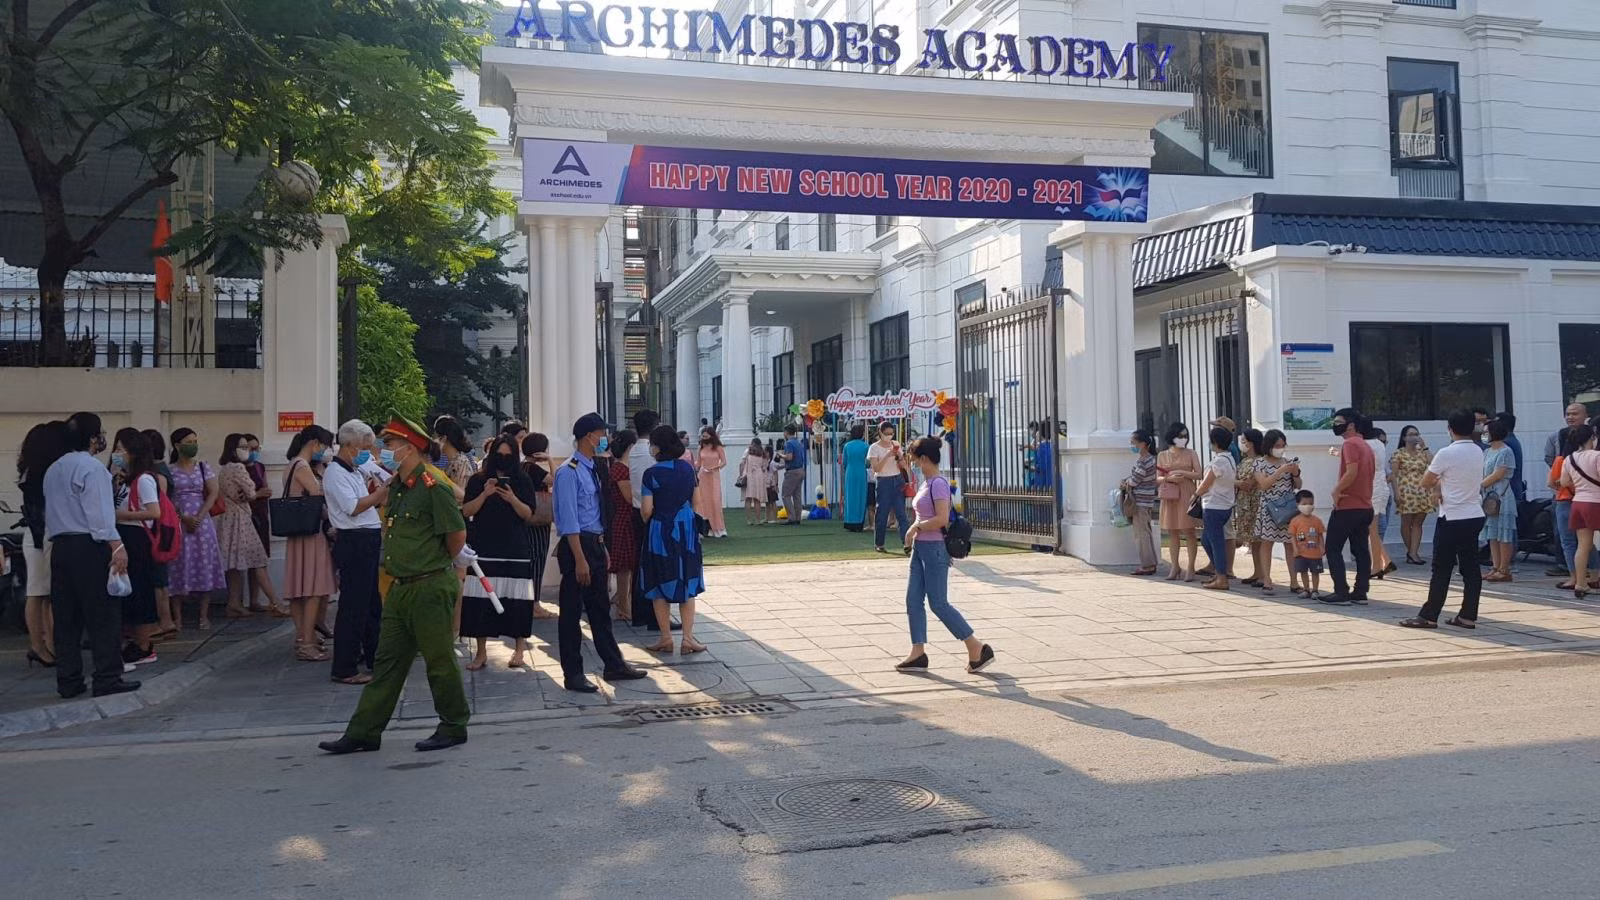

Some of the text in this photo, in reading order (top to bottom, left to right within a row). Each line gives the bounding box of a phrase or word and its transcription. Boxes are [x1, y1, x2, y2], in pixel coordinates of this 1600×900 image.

[505, 0, 1175, 82] ARCHIMEDES ACADEMY
[540, 178, 602, 188] ARCHIMEDES
[650, 162, 730, 190] HAPPY
[737, 167, 793, 194] NEW
[799, 171, 888, 198] SCHOOL
[895, 174, 953, 201] YEAR
[958, 178, 1012, 203] 2020
[1033, 180, 1084, 205] 2021
[828, 388, 937, 411] Happy new school Year
[856, 409, 878, 417] 2020
[885, 408, 905, 417] 2021
